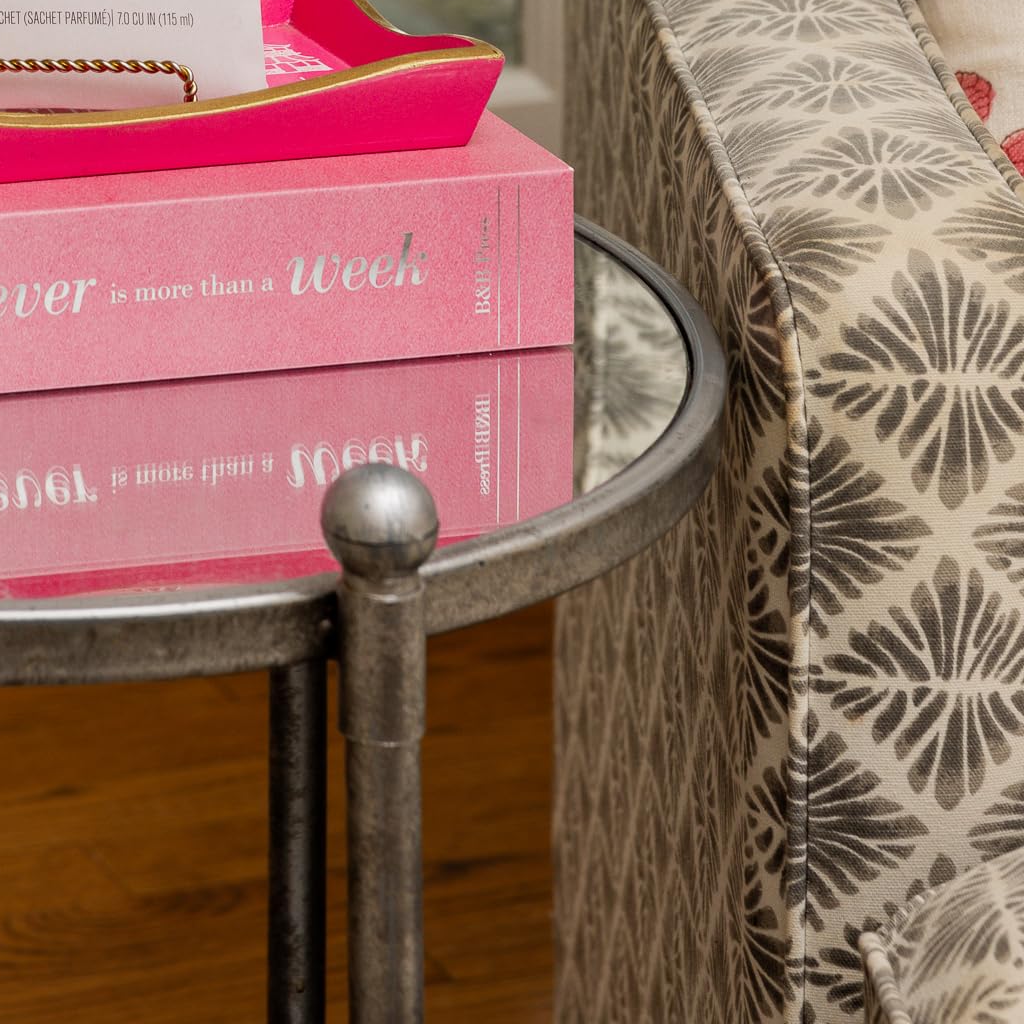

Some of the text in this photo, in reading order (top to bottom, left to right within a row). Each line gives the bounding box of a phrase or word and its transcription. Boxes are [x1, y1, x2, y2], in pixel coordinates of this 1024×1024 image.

[23, 11, 63, 27] (SACHET
[117, 11, 130, 26] 7.0
[132, 11, 144, 26] CU
[146, 12, 156, 26] IN
[158, 12, 177, 28] (115
[179, 12, 194, 28] ml)
[109, 282, 128, 306] is
[134, 280, 194, 304] more
[200, 273, 254, 298] than
[260, 275, 274, 293] a
[286, 231, 429, 296] week
